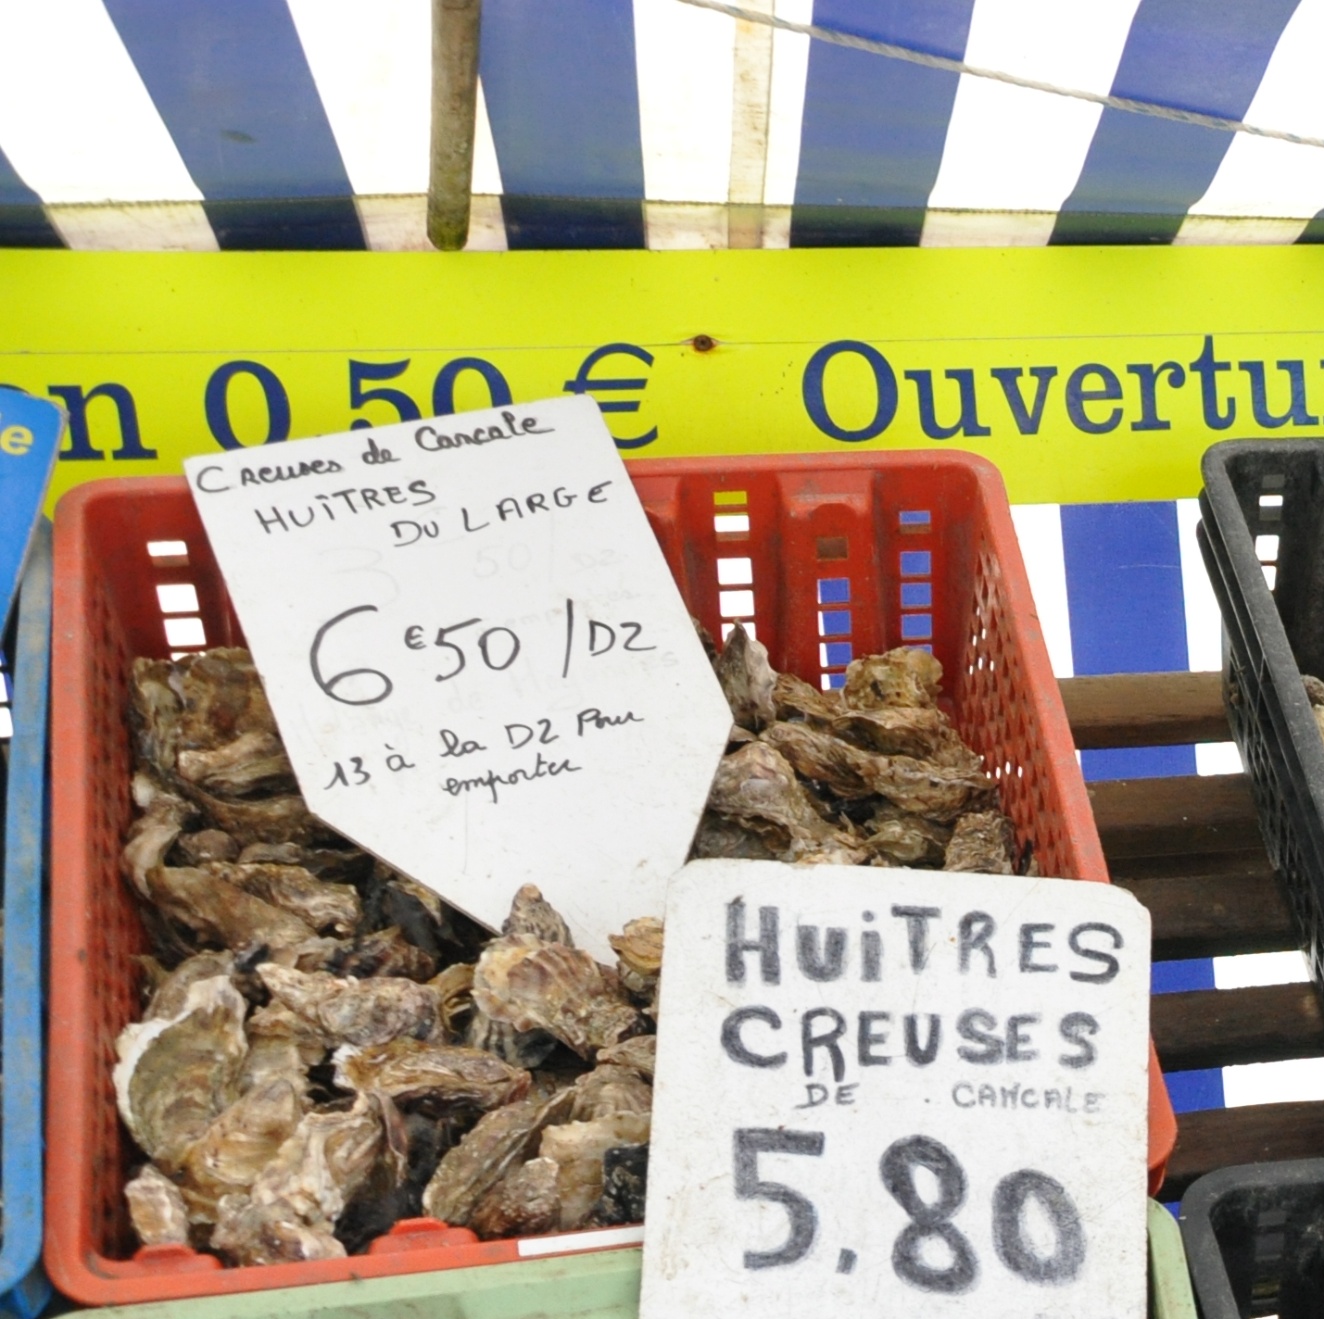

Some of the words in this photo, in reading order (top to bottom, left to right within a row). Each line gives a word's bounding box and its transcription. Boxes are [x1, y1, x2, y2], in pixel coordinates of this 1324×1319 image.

[562, 342, 658, 449] €
[361, 438, 400, 465] de
[414, 411, 555, 451] Cancale
[390, 520, 440, 547] DU
[461, 480, 612, 532] LARGE
[323, 756, 371, 790] 13
[385, 743, 416, 772] à
[439, 729, 488, 758] la
[720, 1005, 1100, 1083] CREUSES
[795, 1082, 860, 1109] DE
[951, 1082, 1106, 1114] CANCALE
[732, 1127, 1088, 1296] 5.80
